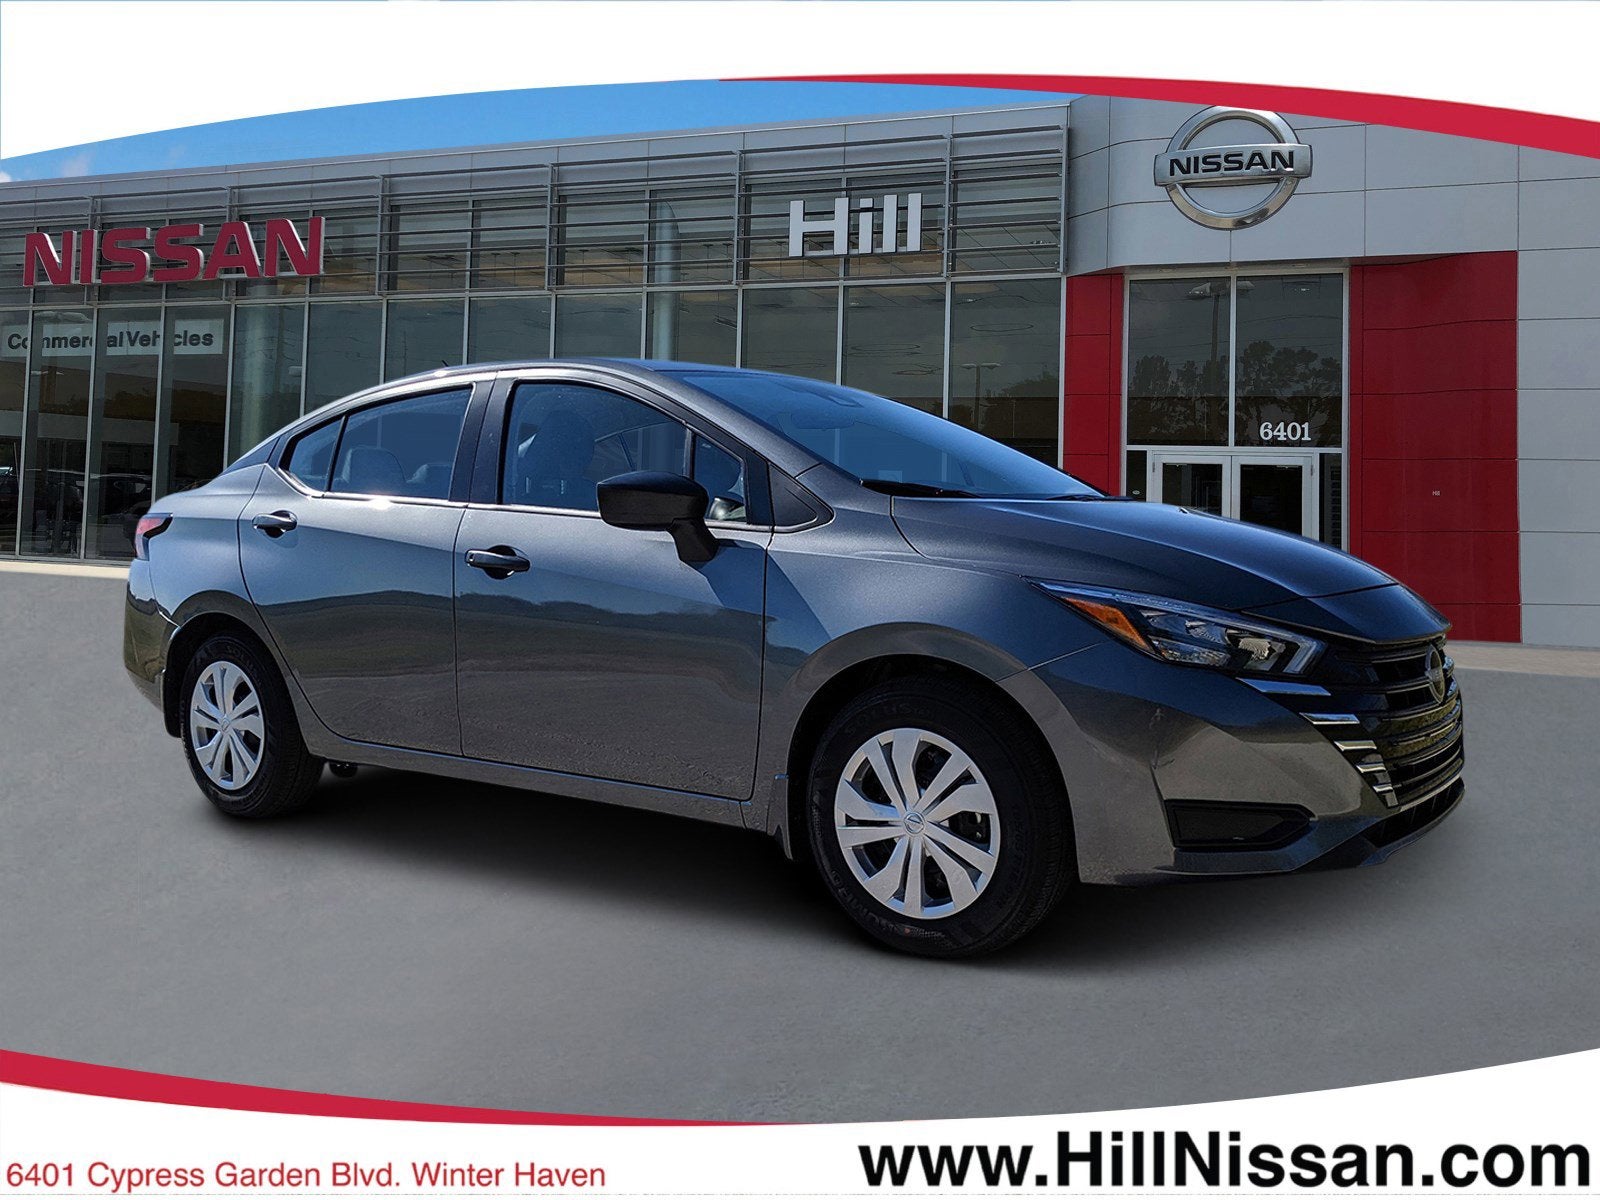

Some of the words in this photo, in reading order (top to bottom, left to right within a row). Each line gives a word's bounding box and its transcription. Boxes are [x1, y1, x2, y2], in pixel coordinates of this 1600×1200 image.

[1169, 150, 1294, 177] NISSAN
[788, 192, 922, 258] Hill
[23, 216, 326, 288] NISSAN
[126, 330, 214, 347] Vehcles
[1259, 421, 1312, 442] 6401
